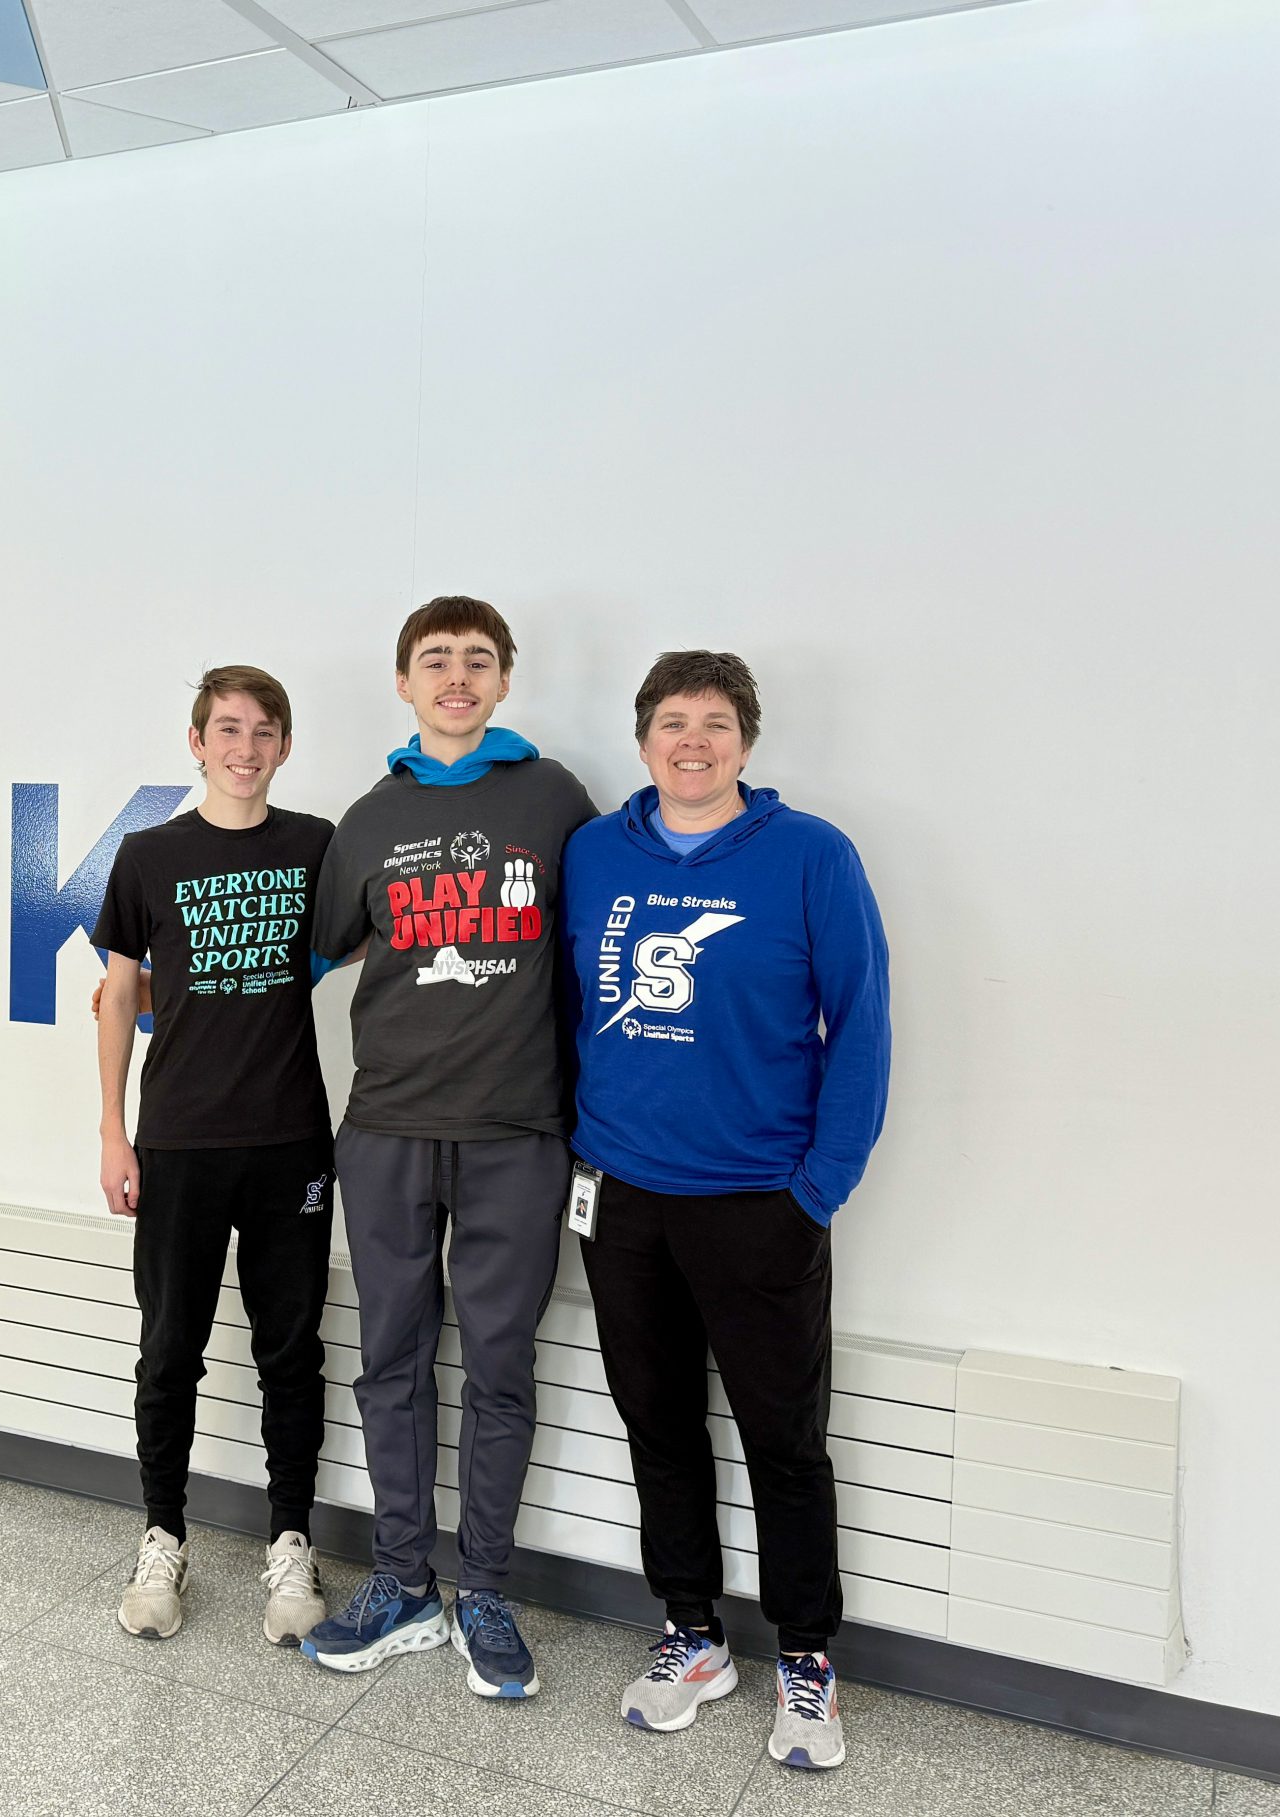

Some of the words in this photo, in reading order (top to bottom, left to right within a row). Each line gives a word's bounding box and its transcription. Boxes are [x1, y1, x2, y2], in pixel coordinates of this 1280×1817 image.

[393, 837, 442, 854] Special
[505, 844, 530, 855] Since
[383, 850, 442, 869] Olympics
[399, 865, 419, 876] New
[420, 861, 442, 872] York
[175, 867, 307, 904] EVERYONE
[387, 870, 487, 916] PLAY
[181, 893, 306, 927] WATCHES
[646, 894, 678, 907] Blue
[681, 896, 737, 910] Streaks
[190, 919, 299, 949] UNIFIED
[390, 906, 541, 950] UNIFIED
[189, 944, 290, 973] SPORTS.
[598, 895, 636, 1003] UNIFIED
[243, 972, 265, 981] Special
[266, 970, 289, 979] Olympics
[431, 957, 517, 976] NYSPHSAA
[631, 932, 696, 1014] S
[241, 986, 267, 995] Schools
[242, 979, 267, 988] Unified
[643, 1031, 670, 1039] Unified
[670, 1033, 695, 1042] Sports
[667, 1025, 694, 1035] Olympics
